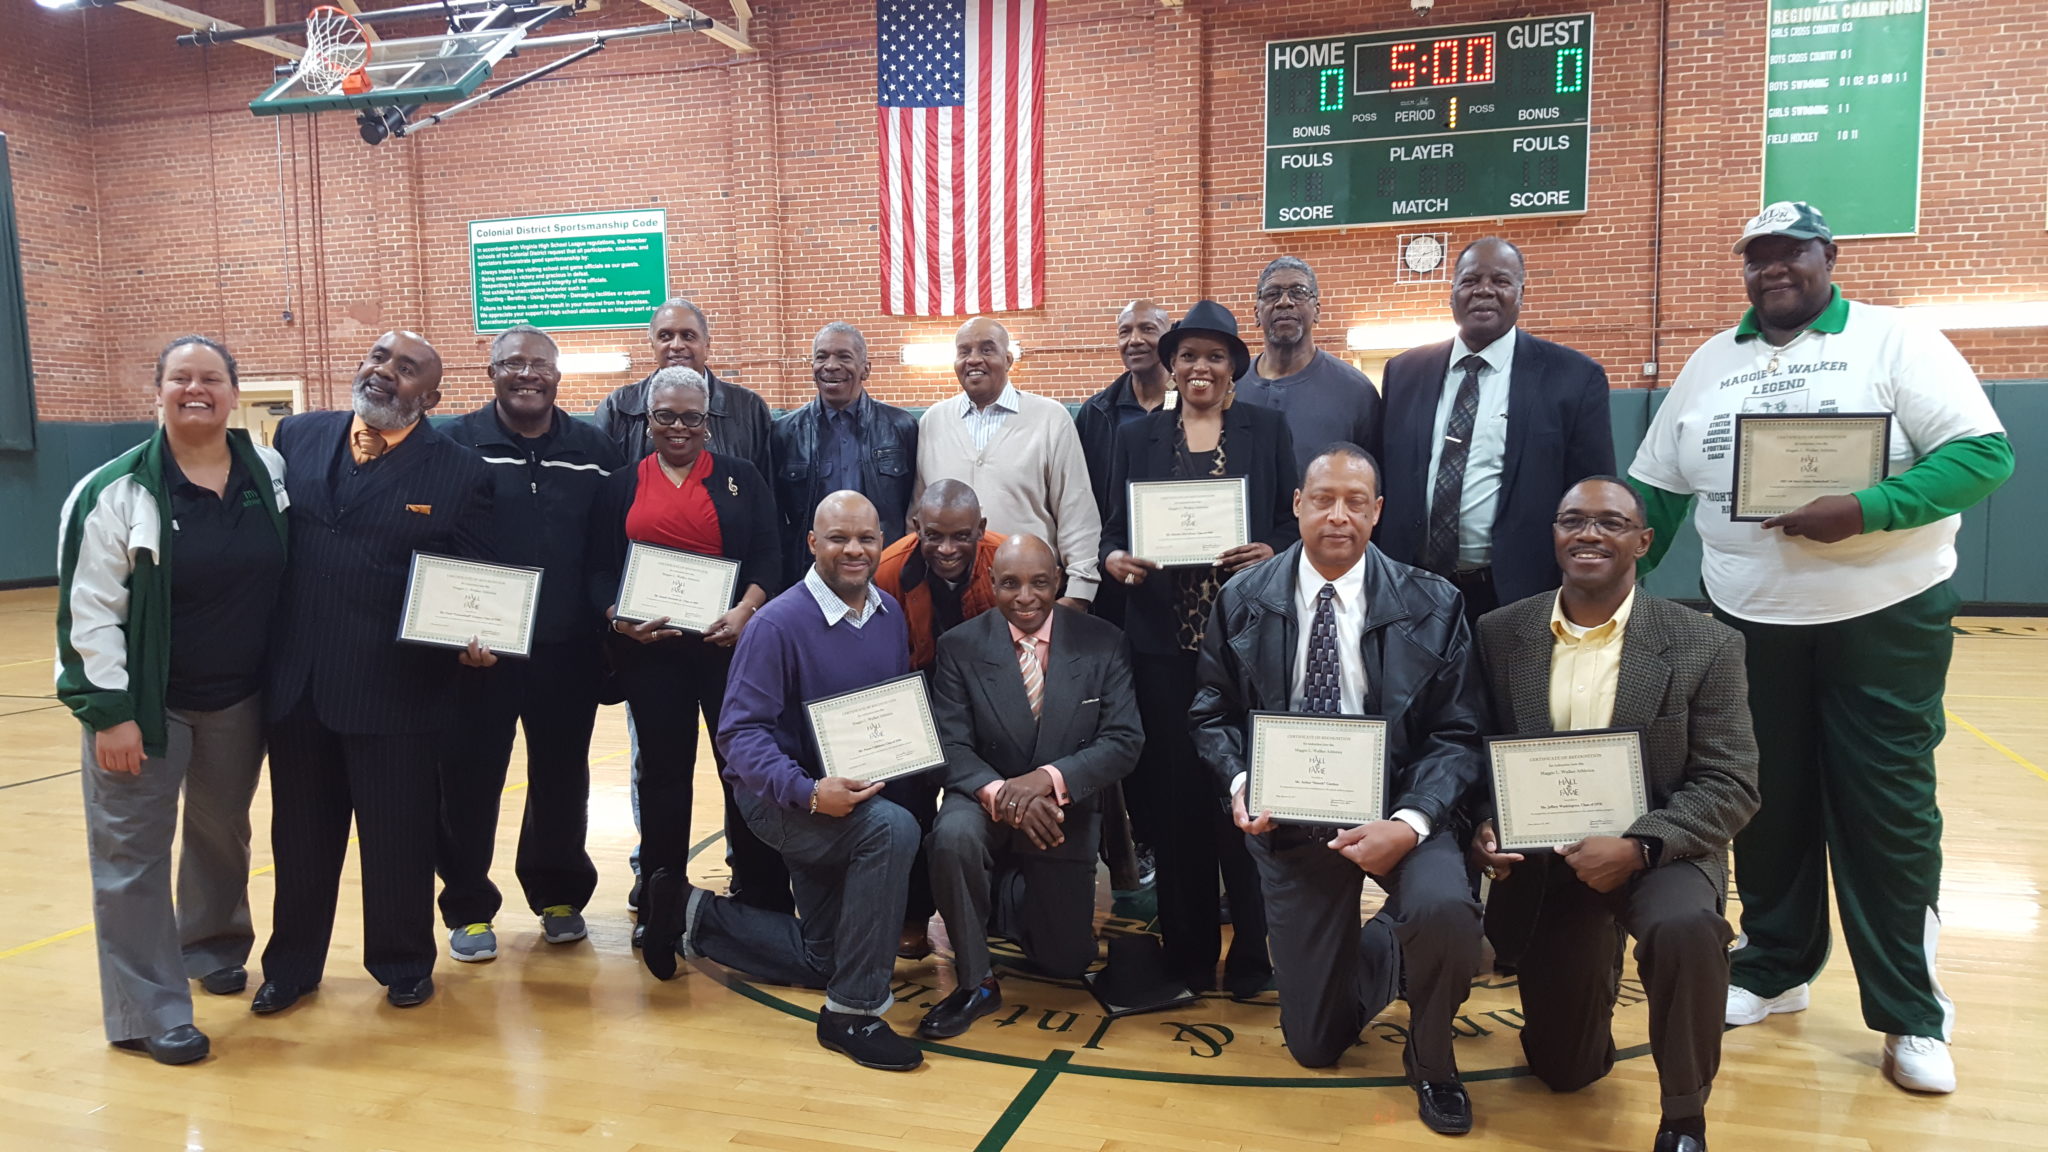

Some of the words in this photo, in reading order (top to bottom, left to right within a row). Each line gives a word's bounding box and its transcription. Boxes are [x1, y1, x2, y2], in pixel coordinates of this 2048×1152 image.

[1773, 5, 1838, 25] REGIONAL
[1842, 0, 1923, 19] CHAMPIONS
[1507, 20, 1584, 49] GUEST
[1771, 27, 1789, 38] GIRLS
[1790, 26, 1810, 37] CROSS
[1812, 23, 1840, 35] COUNTRY
[1274, 42, 1345, 70] HOME
[1390, 36, 1492, 88] 5:00
[1770, 53, 1786, 65] BOYS
[1788, 51, 1808, 63] CROSS
[1809, 50, 1837, 62] COUNTRY
[1556, 48, 1583, 93] 0
[1319, 67, 1344, 112] 0
[1769, 80, 1788, 92] BOYS
[1791, 78, 1829, 90] SWIMMING
[1853, 75, 1864, 86] 02
[1352, 112, 1377, 122] POSS
[1395, 108, 1436, 123] PERIOD
[1449, 96, 1458, 128] 1
[1469, 104, 1495, 114] POSS
[1518, 107, 1560, 121] BONUS
[1768, 107, 1789, 119] GIRLS
[1791, 105, 1829, 117] SWIMMING
[1292, 124, 1331, 138] BONUS
[1767, 133, 1788, 145] FIELD
[1790, 131, 1819, 143] HOCKEY
[1390, 143, 1454, 162] PLAYER
[1513, 135, 1570, 153] FOULS
[1281, 152, 1333, 169] FOULS
[1392, 198, 1449, 215] MATCH
[1510, 190, 1570, 207] SCORE
[1279, 205, 1334, 221] SCORE
[477, 228, 513, 237] Colonial
[517, 225, 550, 234] District
[554, 220, 629, 233] Sportsmanship
[632, 219, 658, 227] Code
[1719, 370, 1767, 390] MAGGIE
[1787, 361, 1848, 375] WALKER
[1752, 378, 1806, 395] LEGEND
[1702, 436, 1733, 445] BASKETBALL
